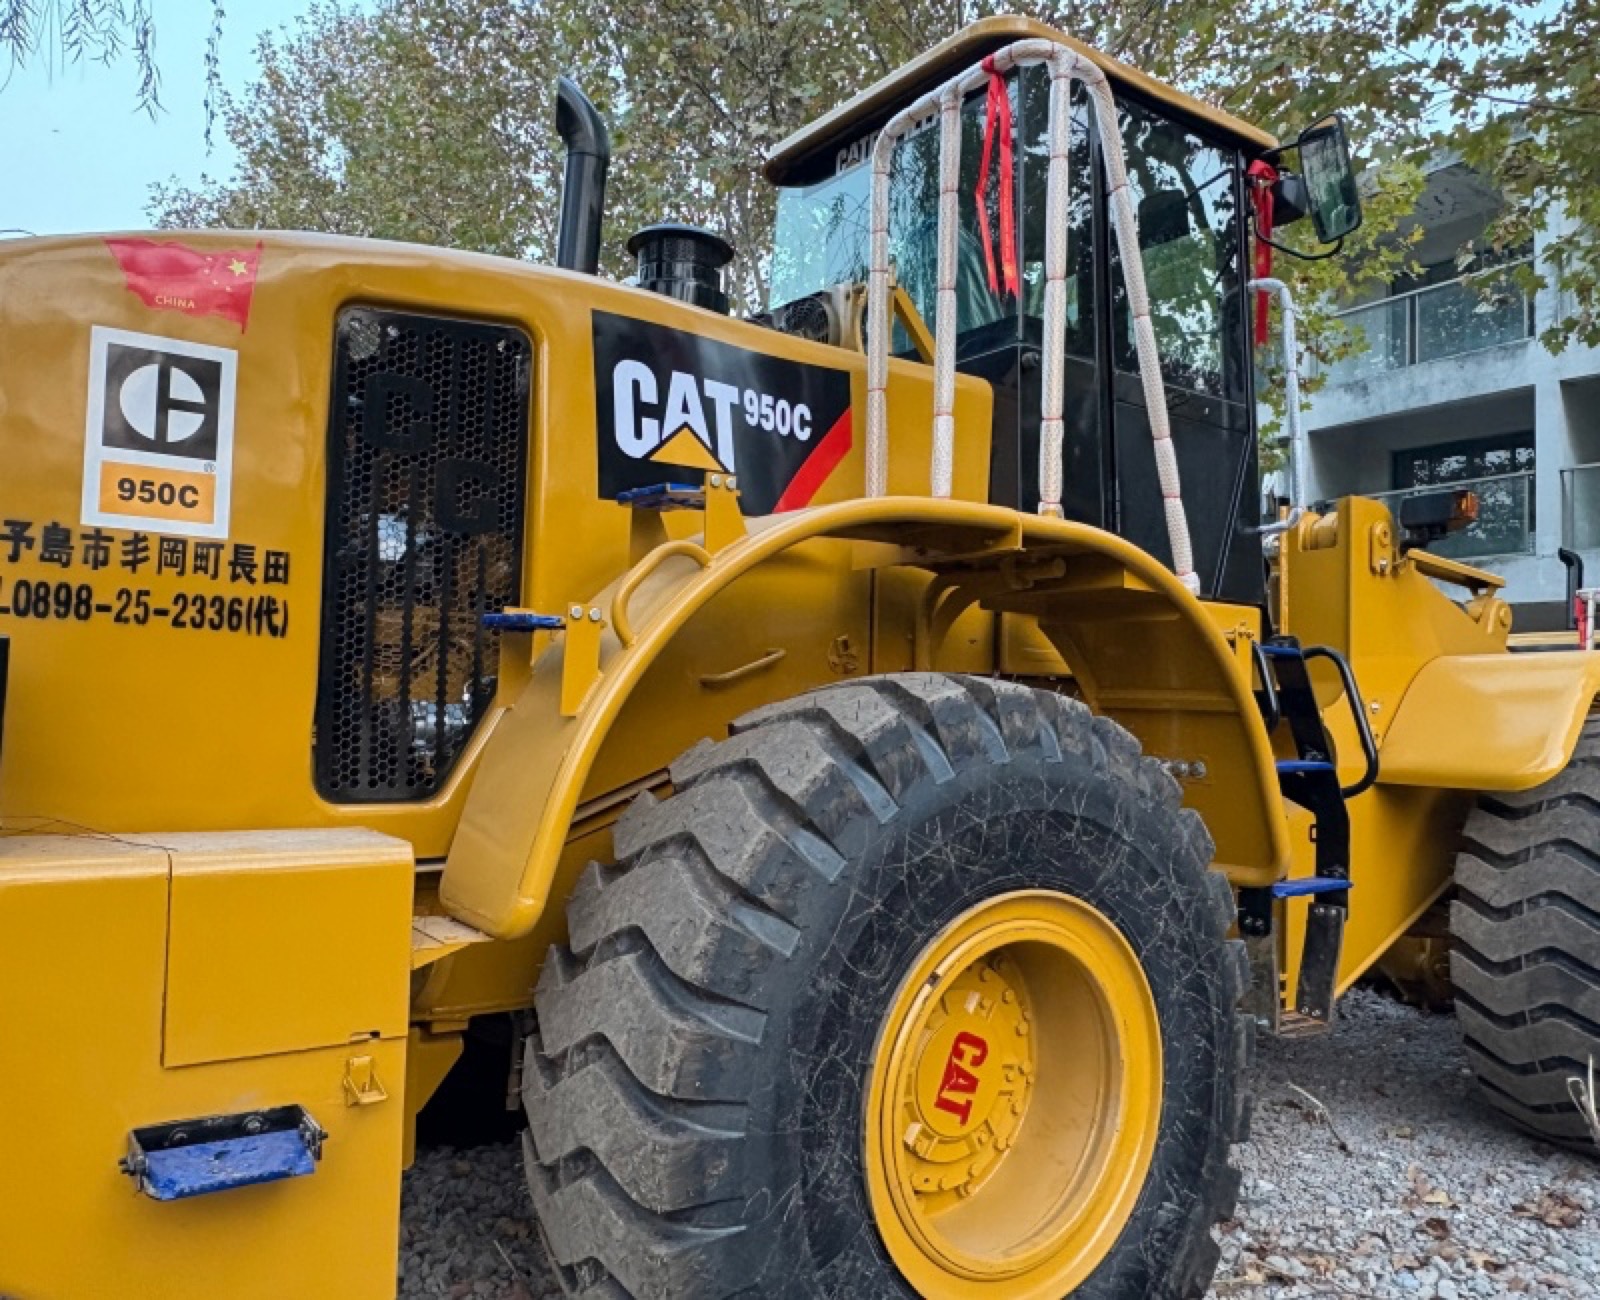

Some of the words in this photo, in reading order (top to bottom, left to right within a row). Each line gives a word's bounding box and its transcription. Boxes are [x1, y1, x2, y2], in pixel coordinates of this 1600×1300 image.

[155, 295, 195, 309] CHINA
[613, 359, 738, 474] CAT
[743, 388, 812, 441] 950C
[117, 477, 199, 508] 950C
[934, 1031, 989, 1127] CAT
